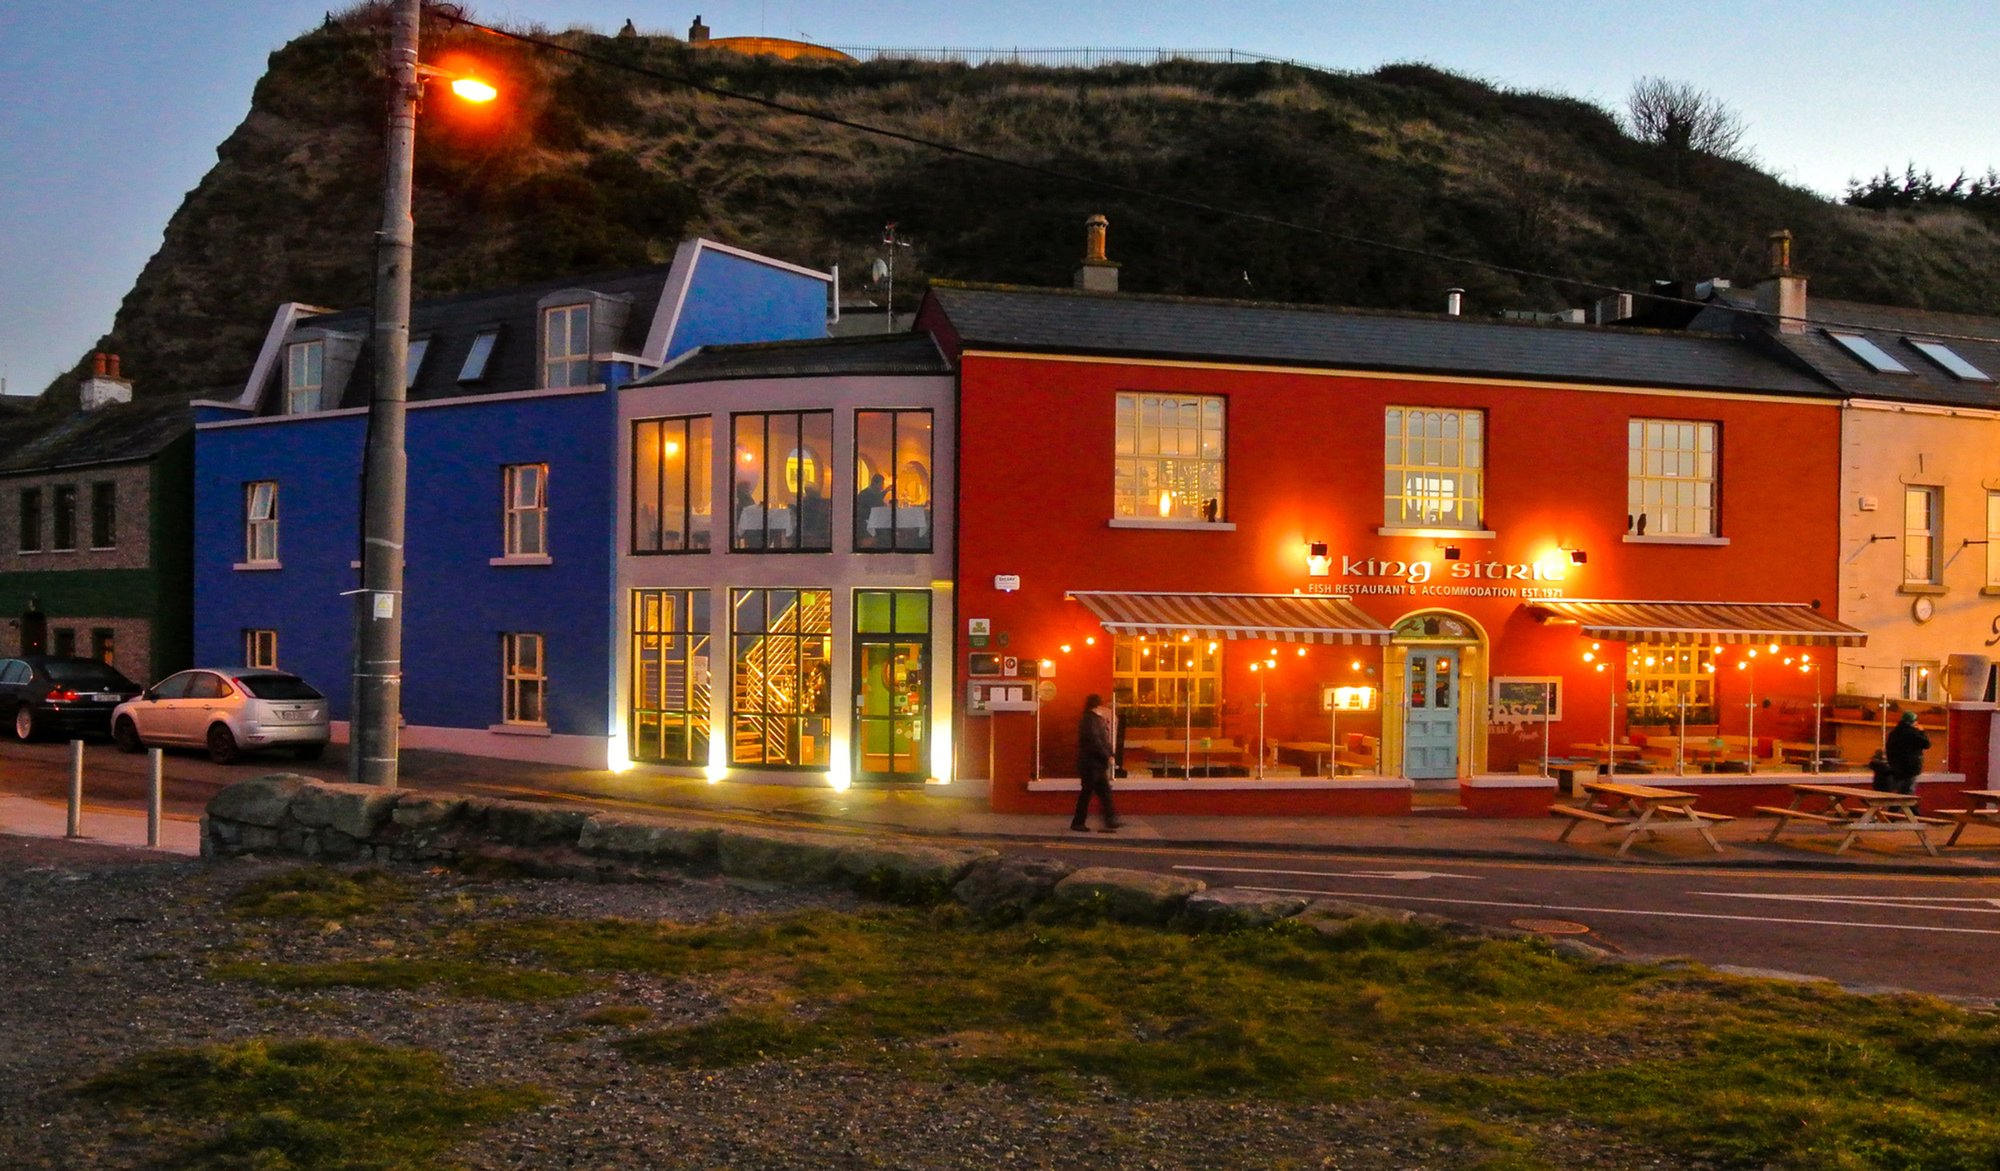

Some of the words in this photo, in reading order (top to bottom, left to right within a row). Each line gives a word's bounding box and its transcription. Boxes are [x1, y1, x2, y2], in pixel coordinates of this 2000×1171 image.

[1309, 584, 1332, 593] FISH
[1336, 584, 1406, 595] RESTAURANT
[1409, 585, 1416, 595] &
[1422, 586, 1517, 597] ACCOMMODATION
